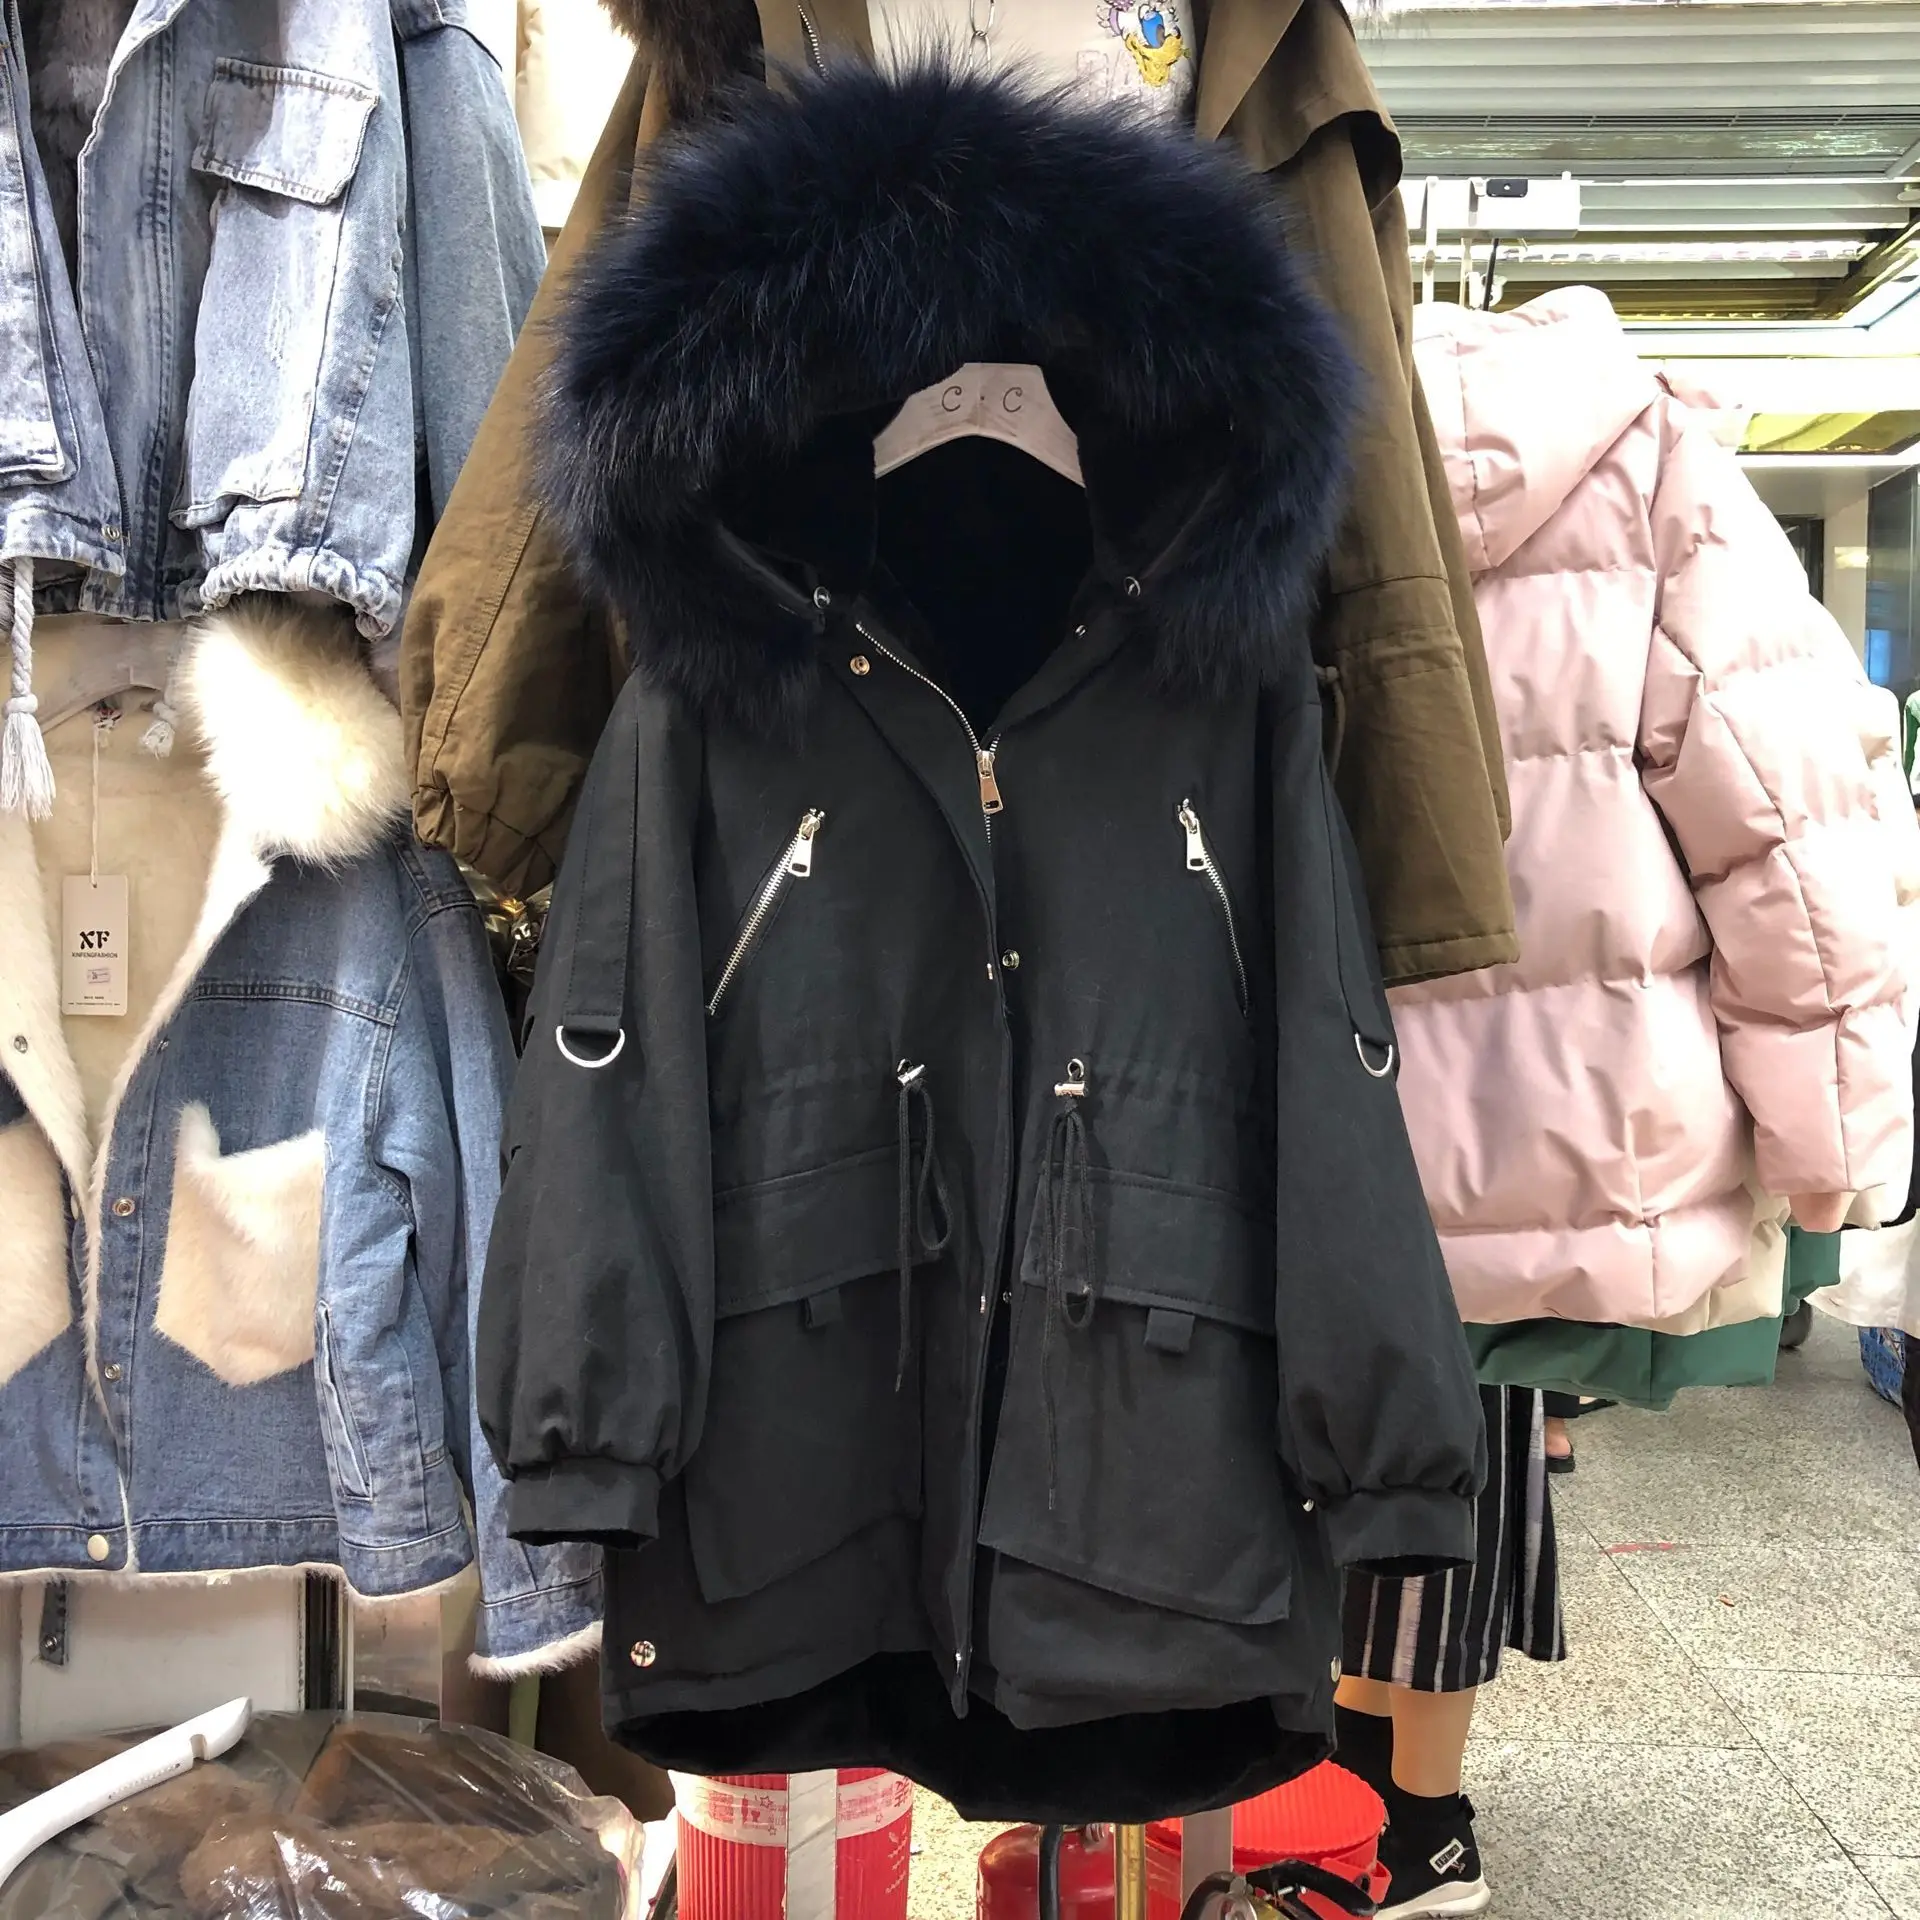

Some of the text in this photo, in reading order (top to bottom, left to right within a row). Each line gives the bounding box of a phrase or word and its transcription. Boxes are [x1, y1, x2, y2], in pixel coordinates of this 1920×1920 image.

[941, 385, 1023, 413] C C
[79, 930, 110, 950] XF
